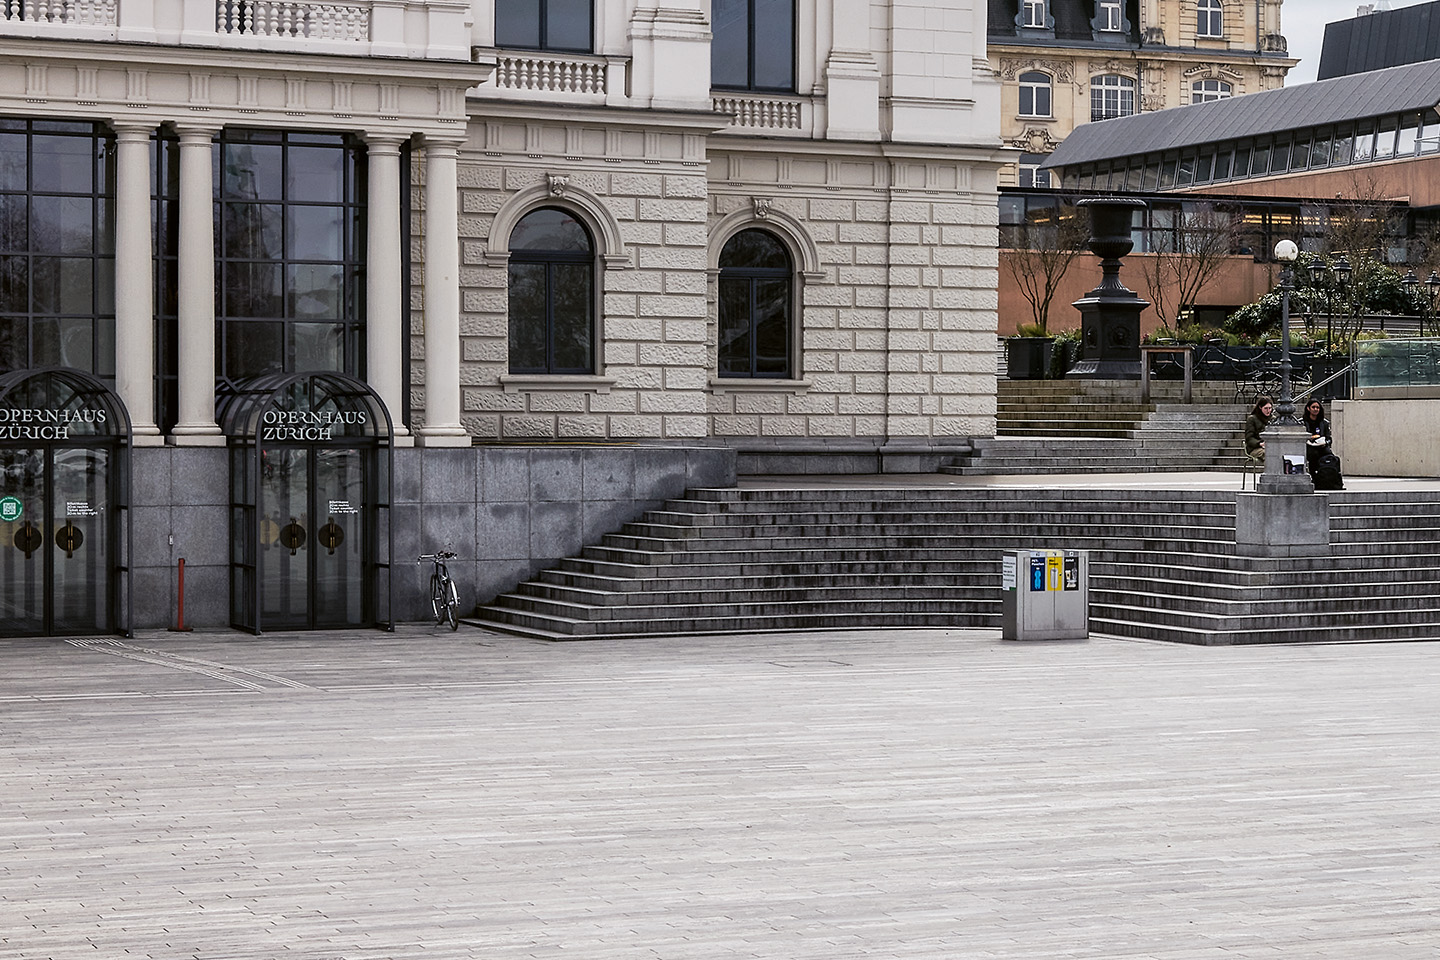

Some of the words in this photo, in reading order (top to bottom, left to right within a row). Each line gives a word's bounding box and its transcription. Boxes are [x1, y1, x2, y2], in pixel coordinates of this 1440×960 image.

[0, 408, 107, 423] OPERNHAUS
[263, 410, 367, 424] OPERNHAUS
[0, 423, 70, 440] ZÜRICH
[263, 424, 333, 440] ZÜRICH
